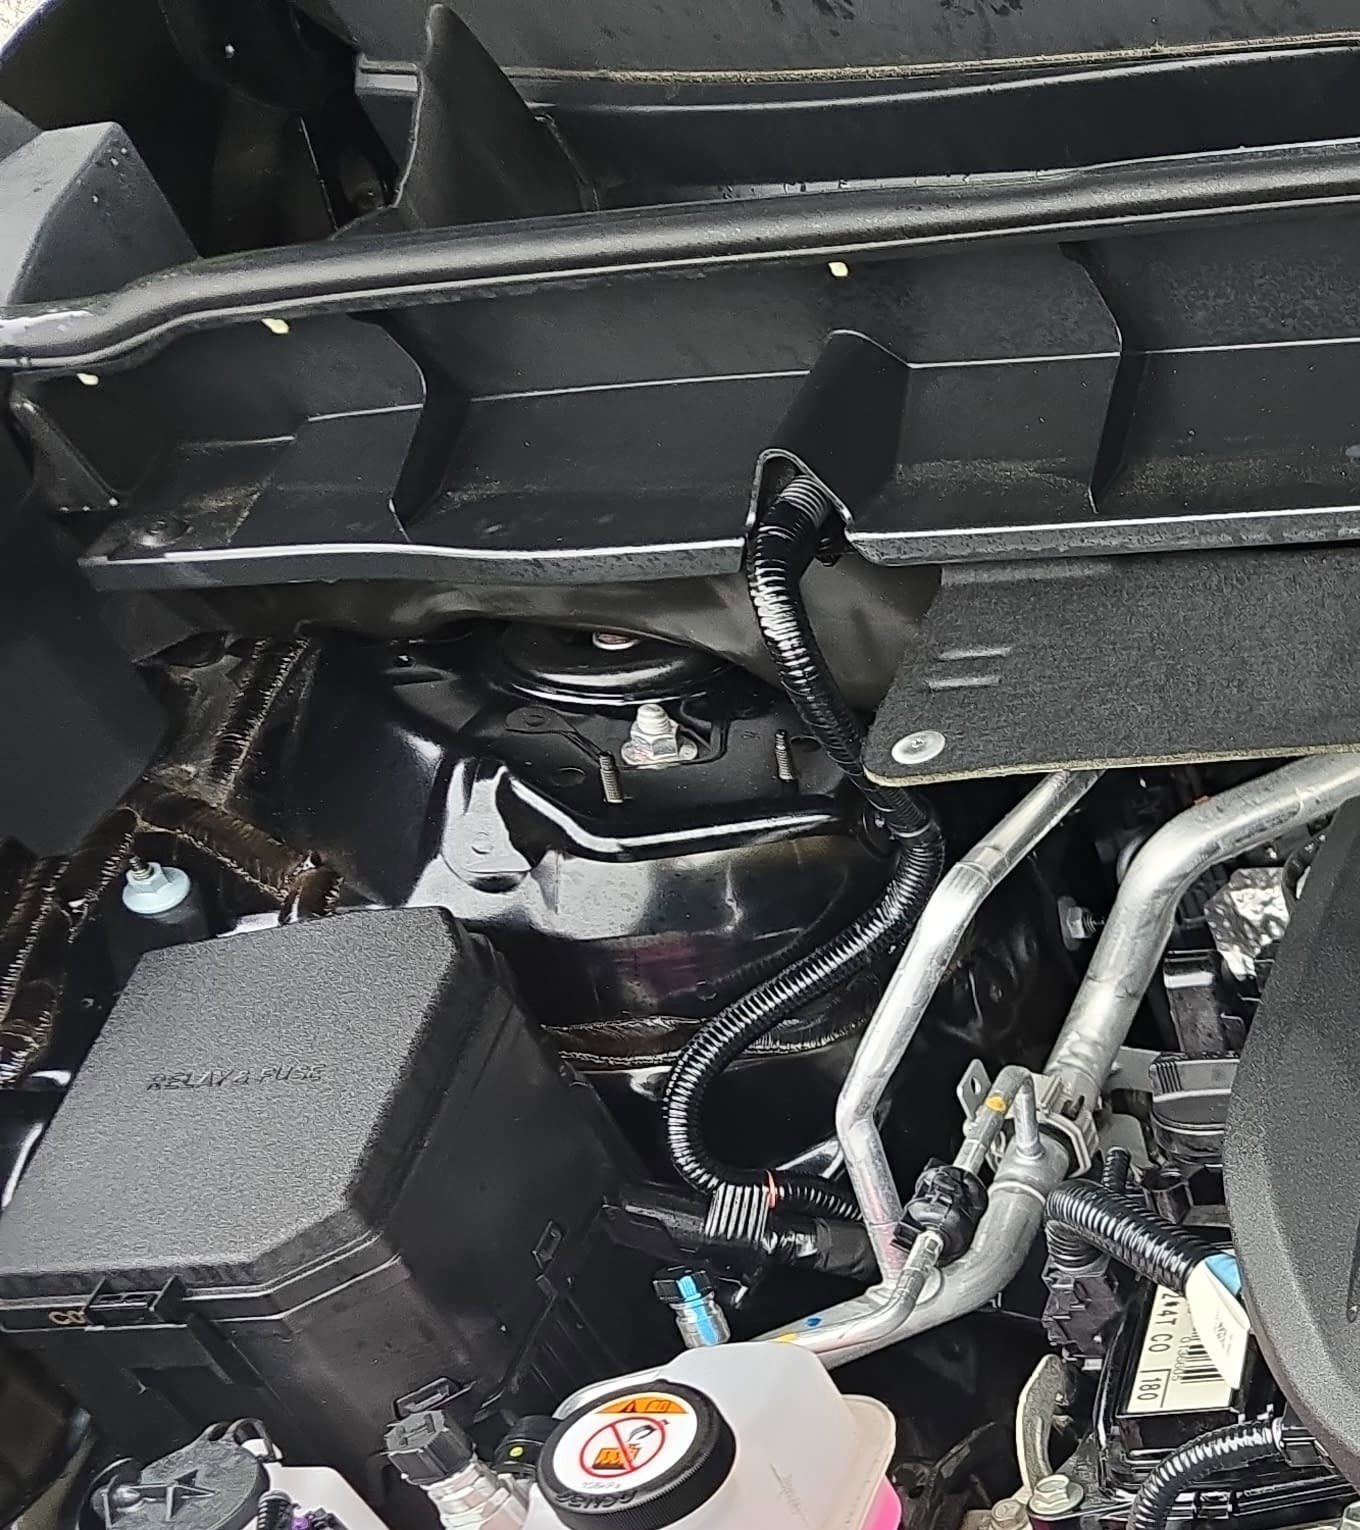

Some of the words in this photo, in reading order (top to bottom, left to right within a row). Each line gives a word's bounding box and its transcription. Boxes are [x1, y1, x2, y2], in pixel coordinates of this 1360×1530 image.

[147, 1069, 234, 1091] RELAY
[257, 1063, 326, 1084] FUSE
[1137, 1377, 1163, 1401] 180
